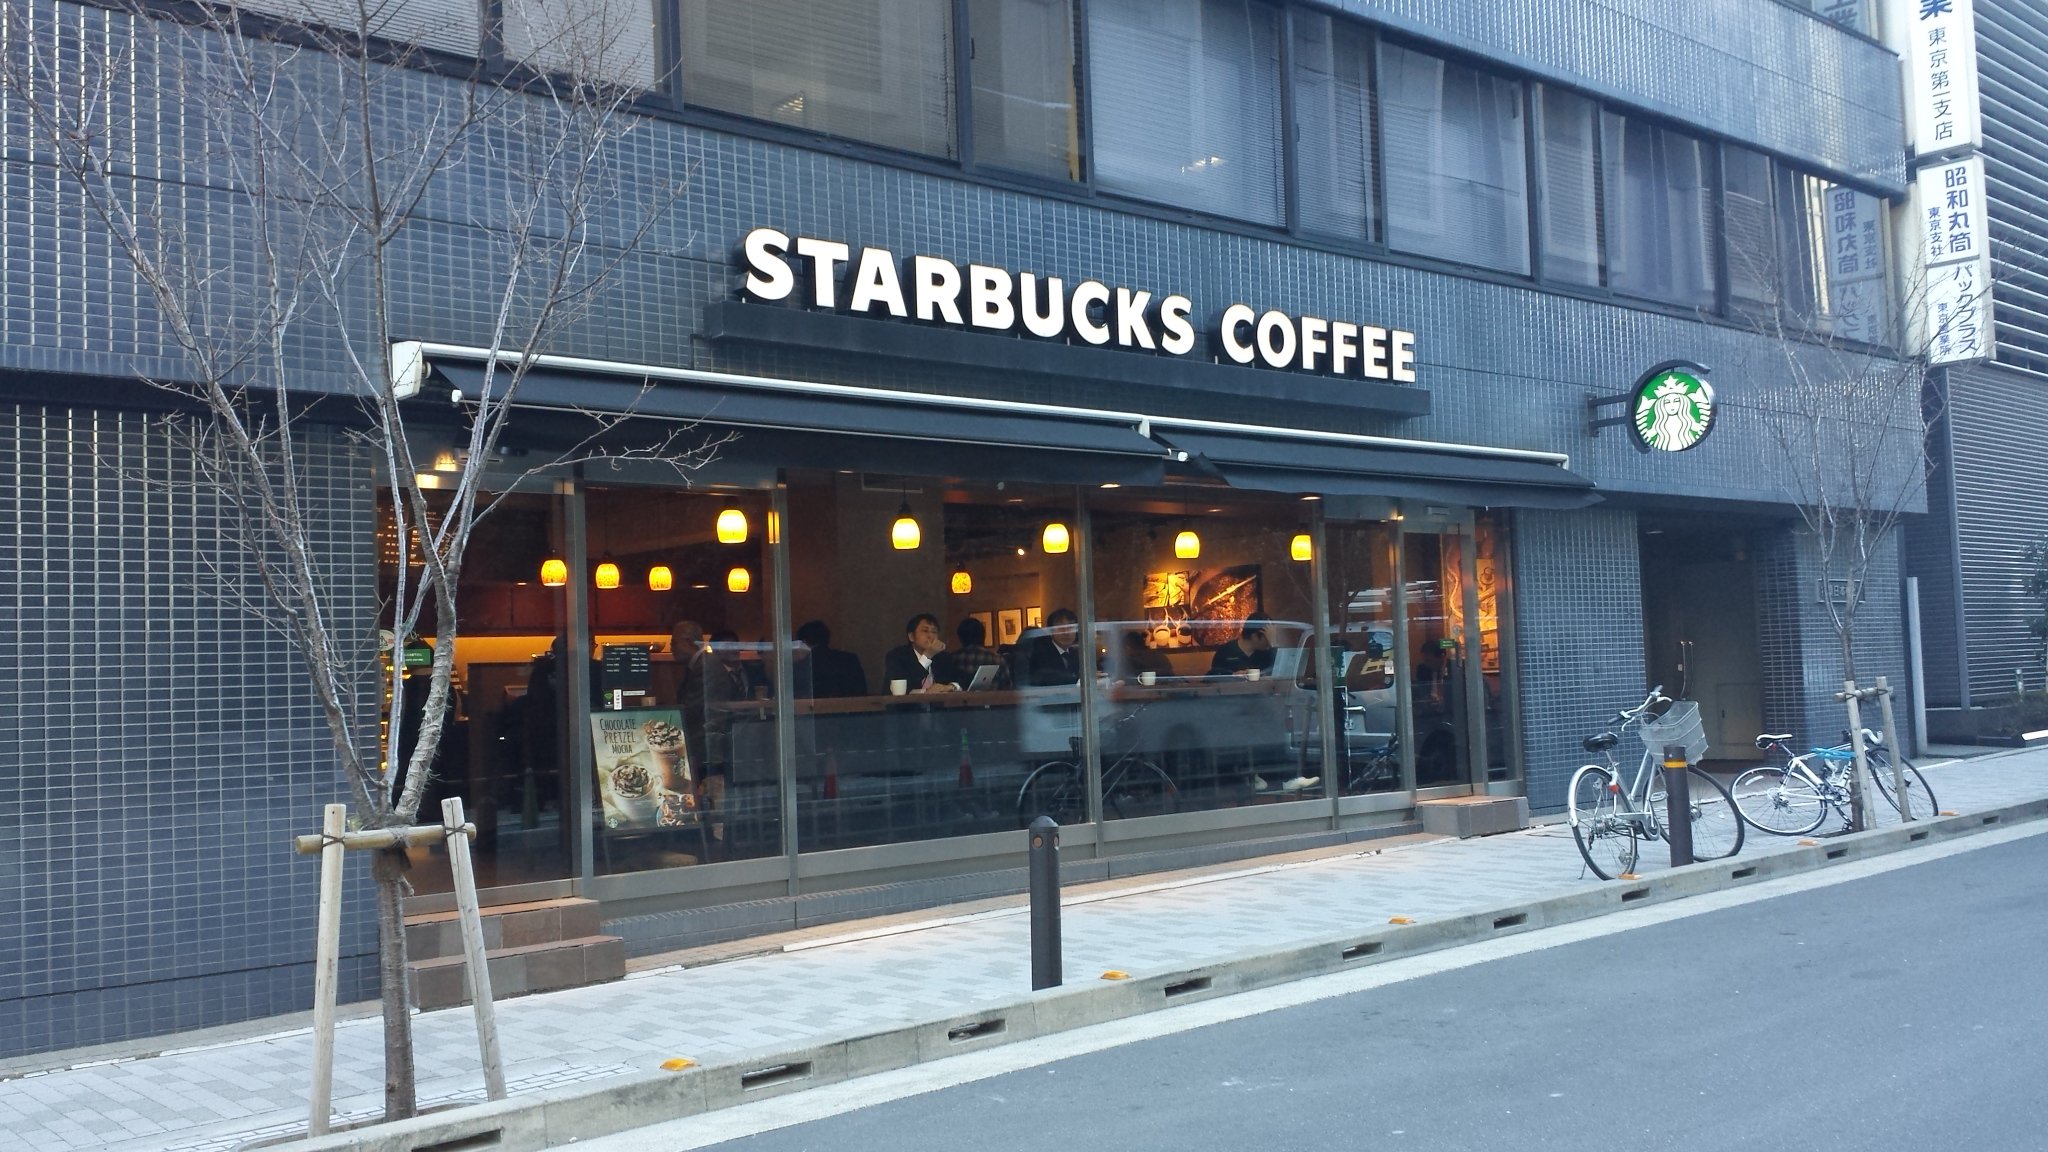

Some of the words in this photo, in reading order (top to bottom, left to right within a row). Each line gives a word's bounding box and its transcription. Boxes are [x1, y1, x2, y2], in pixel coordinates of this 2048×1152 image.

[1928, 26, 1953, 141] 東京第一支店
[1928, 206, 1944, 257] 東京支社
[1945, 166, 1971, 254] 昭和丸筒
[743, 227, 1195, 357] STARBUCKS
[1220, 304, 1417, 384] COFFEE
[600, 718, 637, 731] CHOCOLATE
[603, 730, 636, 744] PRETZEL
[611, 743, 633, 755] MOCHA
